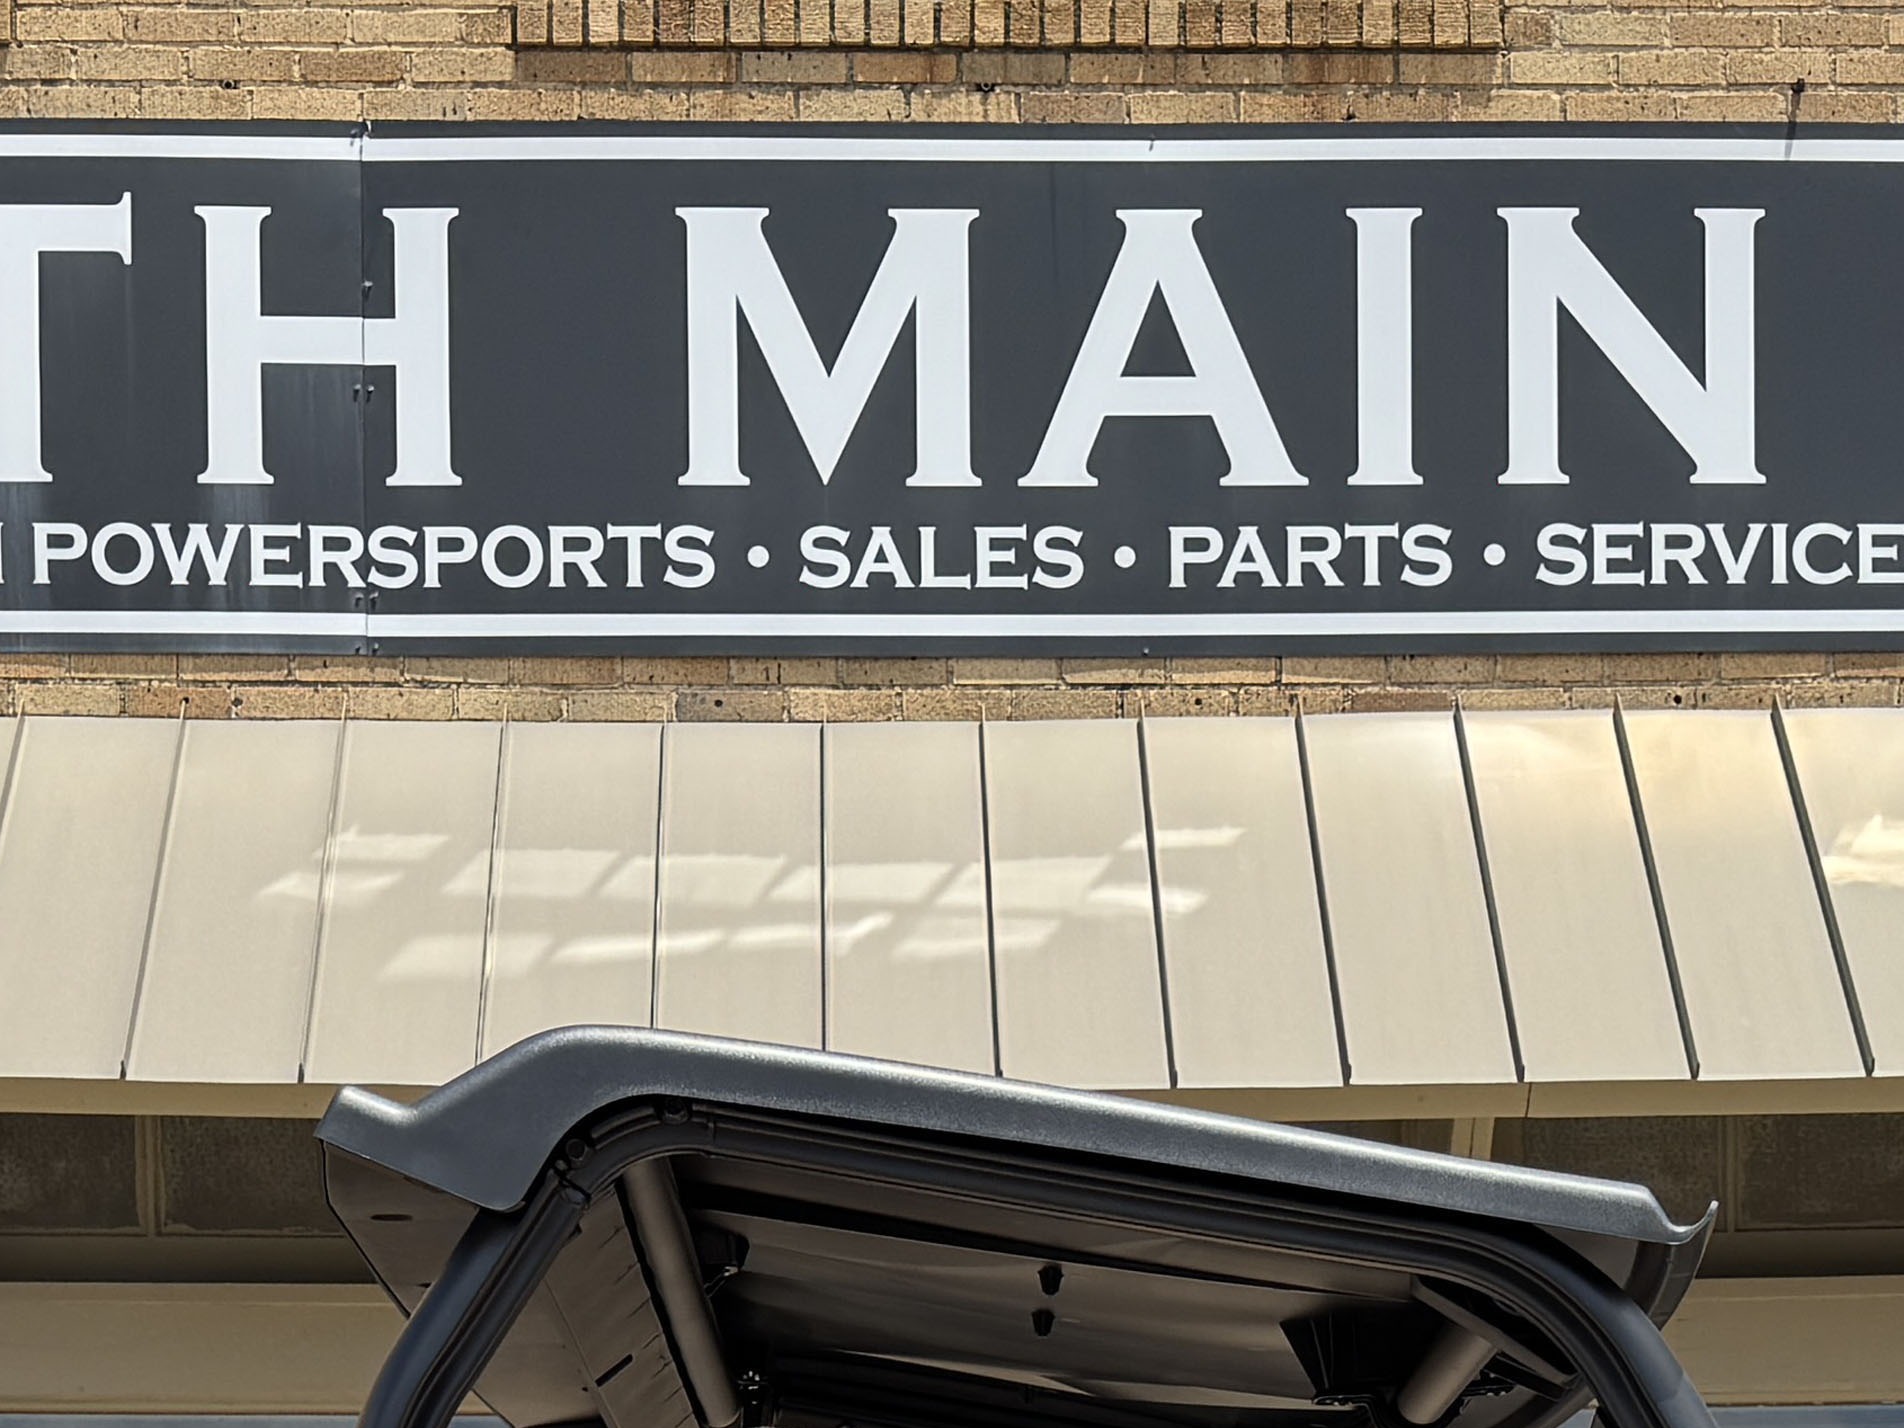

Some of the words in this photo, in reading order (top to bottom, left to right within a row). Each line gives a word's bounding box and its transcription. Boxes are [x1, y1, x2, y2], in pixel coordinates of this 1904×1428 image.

[674, 206, 1767, 487] MAIN
[31, 521, 716, 589] POWERSPORTS
[798, 523, 1085, 590] SALES
[1168, 522, 1453, 588] PARTS
